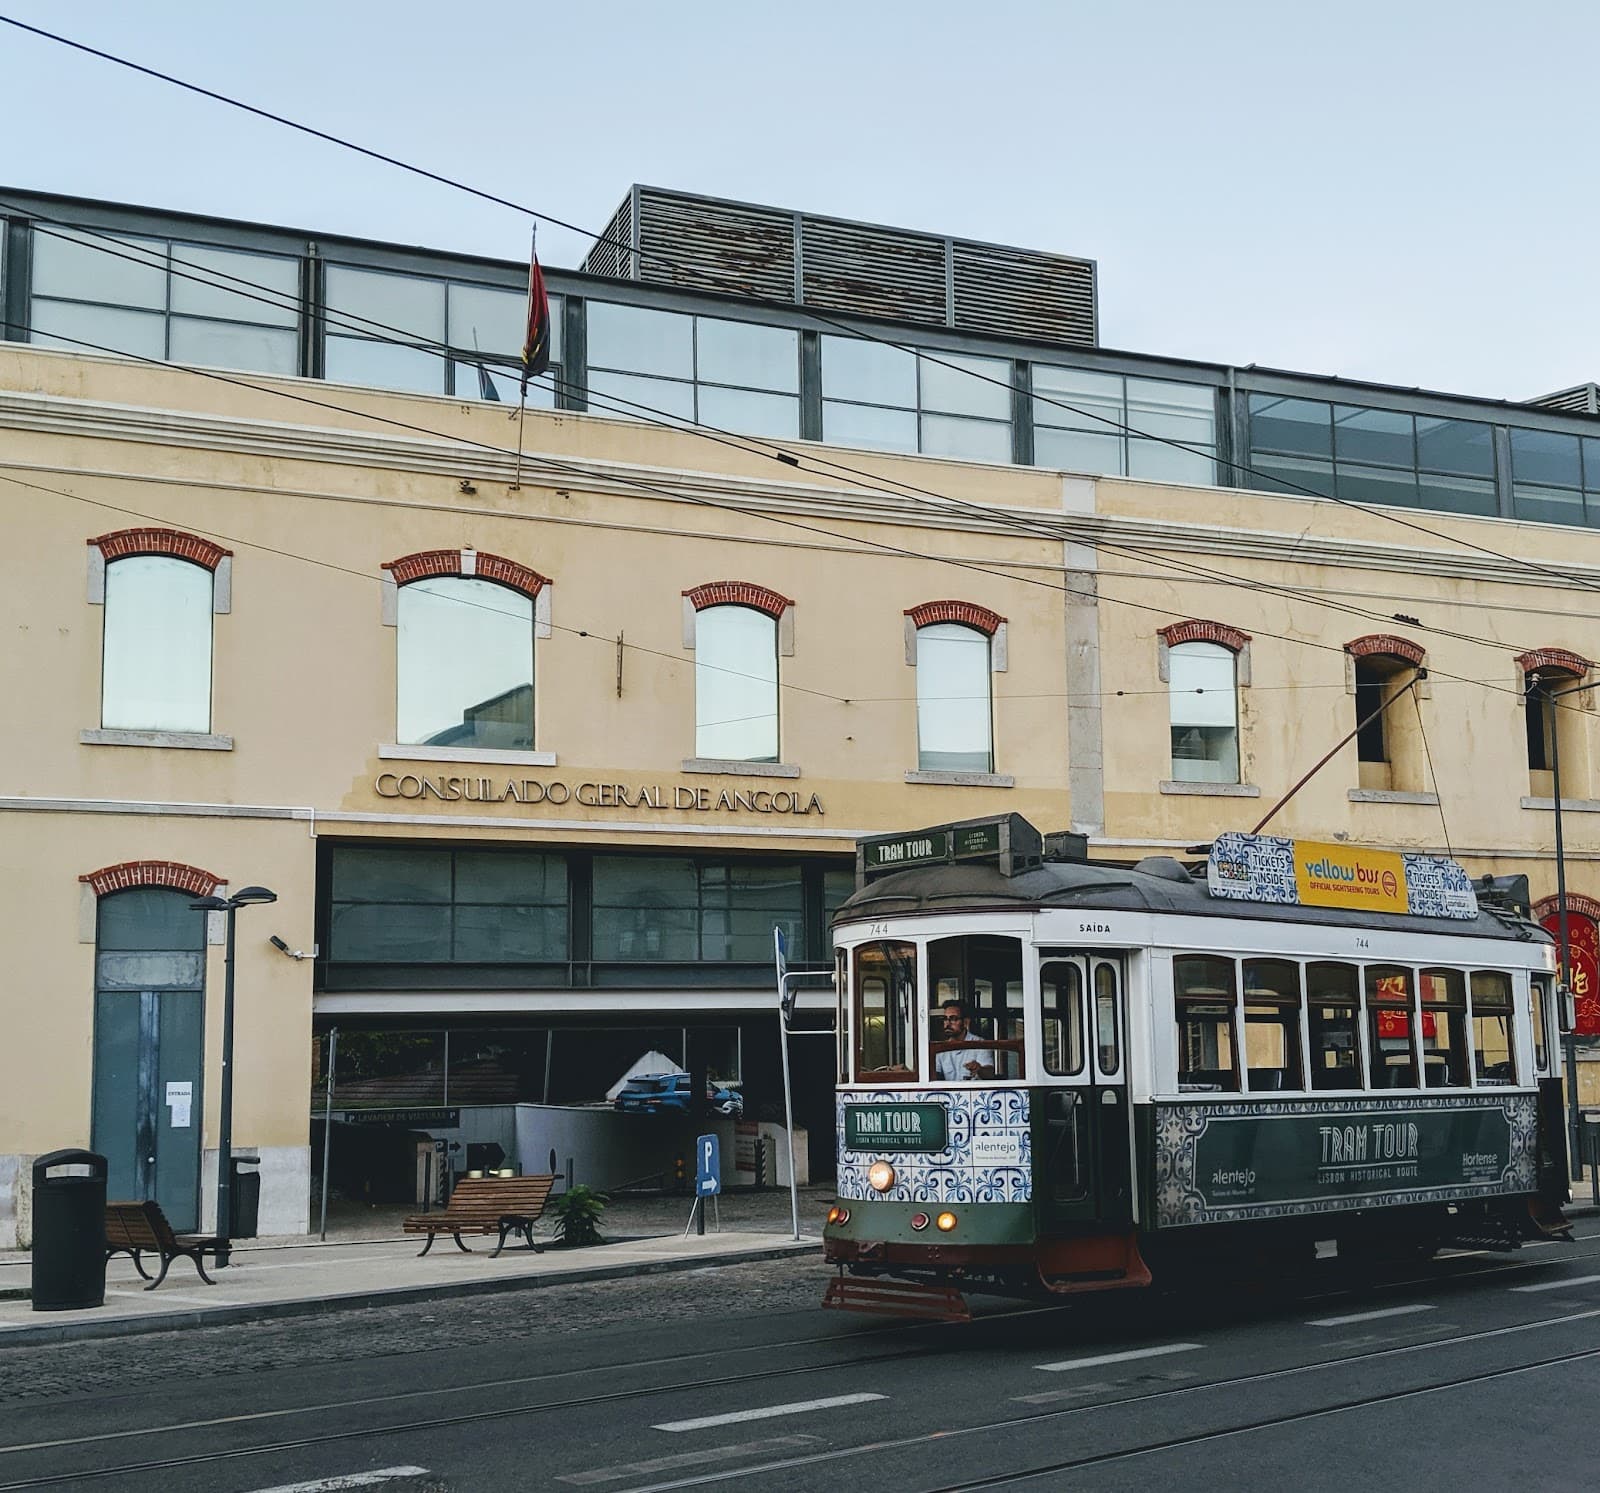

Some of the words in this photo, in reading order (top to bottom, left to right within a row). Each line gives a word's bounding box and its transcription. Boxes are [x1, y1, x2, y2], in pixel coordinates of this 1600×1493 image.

[374, 773, 571, 804] CONSULADO
[575, 783, 669, 808] GERAL
[674, 786, 710, 810] DE
[715, 789, 825, 815] ANGOLA
[878, 843, 904, 862] TRAM
[905, 839, 933, 858] TOUR
[1253, 853, 1286, 869] TICKETS
[1257, 872, 1285, 886] INSIDE
[1356, 862, 1379, 884] bus
[1413, 872, 1441, 885] TICKETS
[1417, 889, 1440, 900] INSIDE
[870, 924, 888, 935] 744
[1356, 938, 1369, 949] 744
[855, 1112, 882, 1133] TRAM
[885, 1111, 922, 1133] TOUR
[975, 1141, 1016, 1154] alentejo
[1319, 1125, 1367, 1162] TRAM
[1373, 1122, 1418, 1159] TOUR
[704, 1141, 713, 1173] P
[1463, 1152, 1498, 1166] Hortense
[1212, 1168, 1256, 1187] alentejo
[1319, 1172, 1345, 1184] LISBON
[1350, 1168, 1391, 1182] HISTORICAL
[1396, 1166, 1418, 1177] ROUTE
